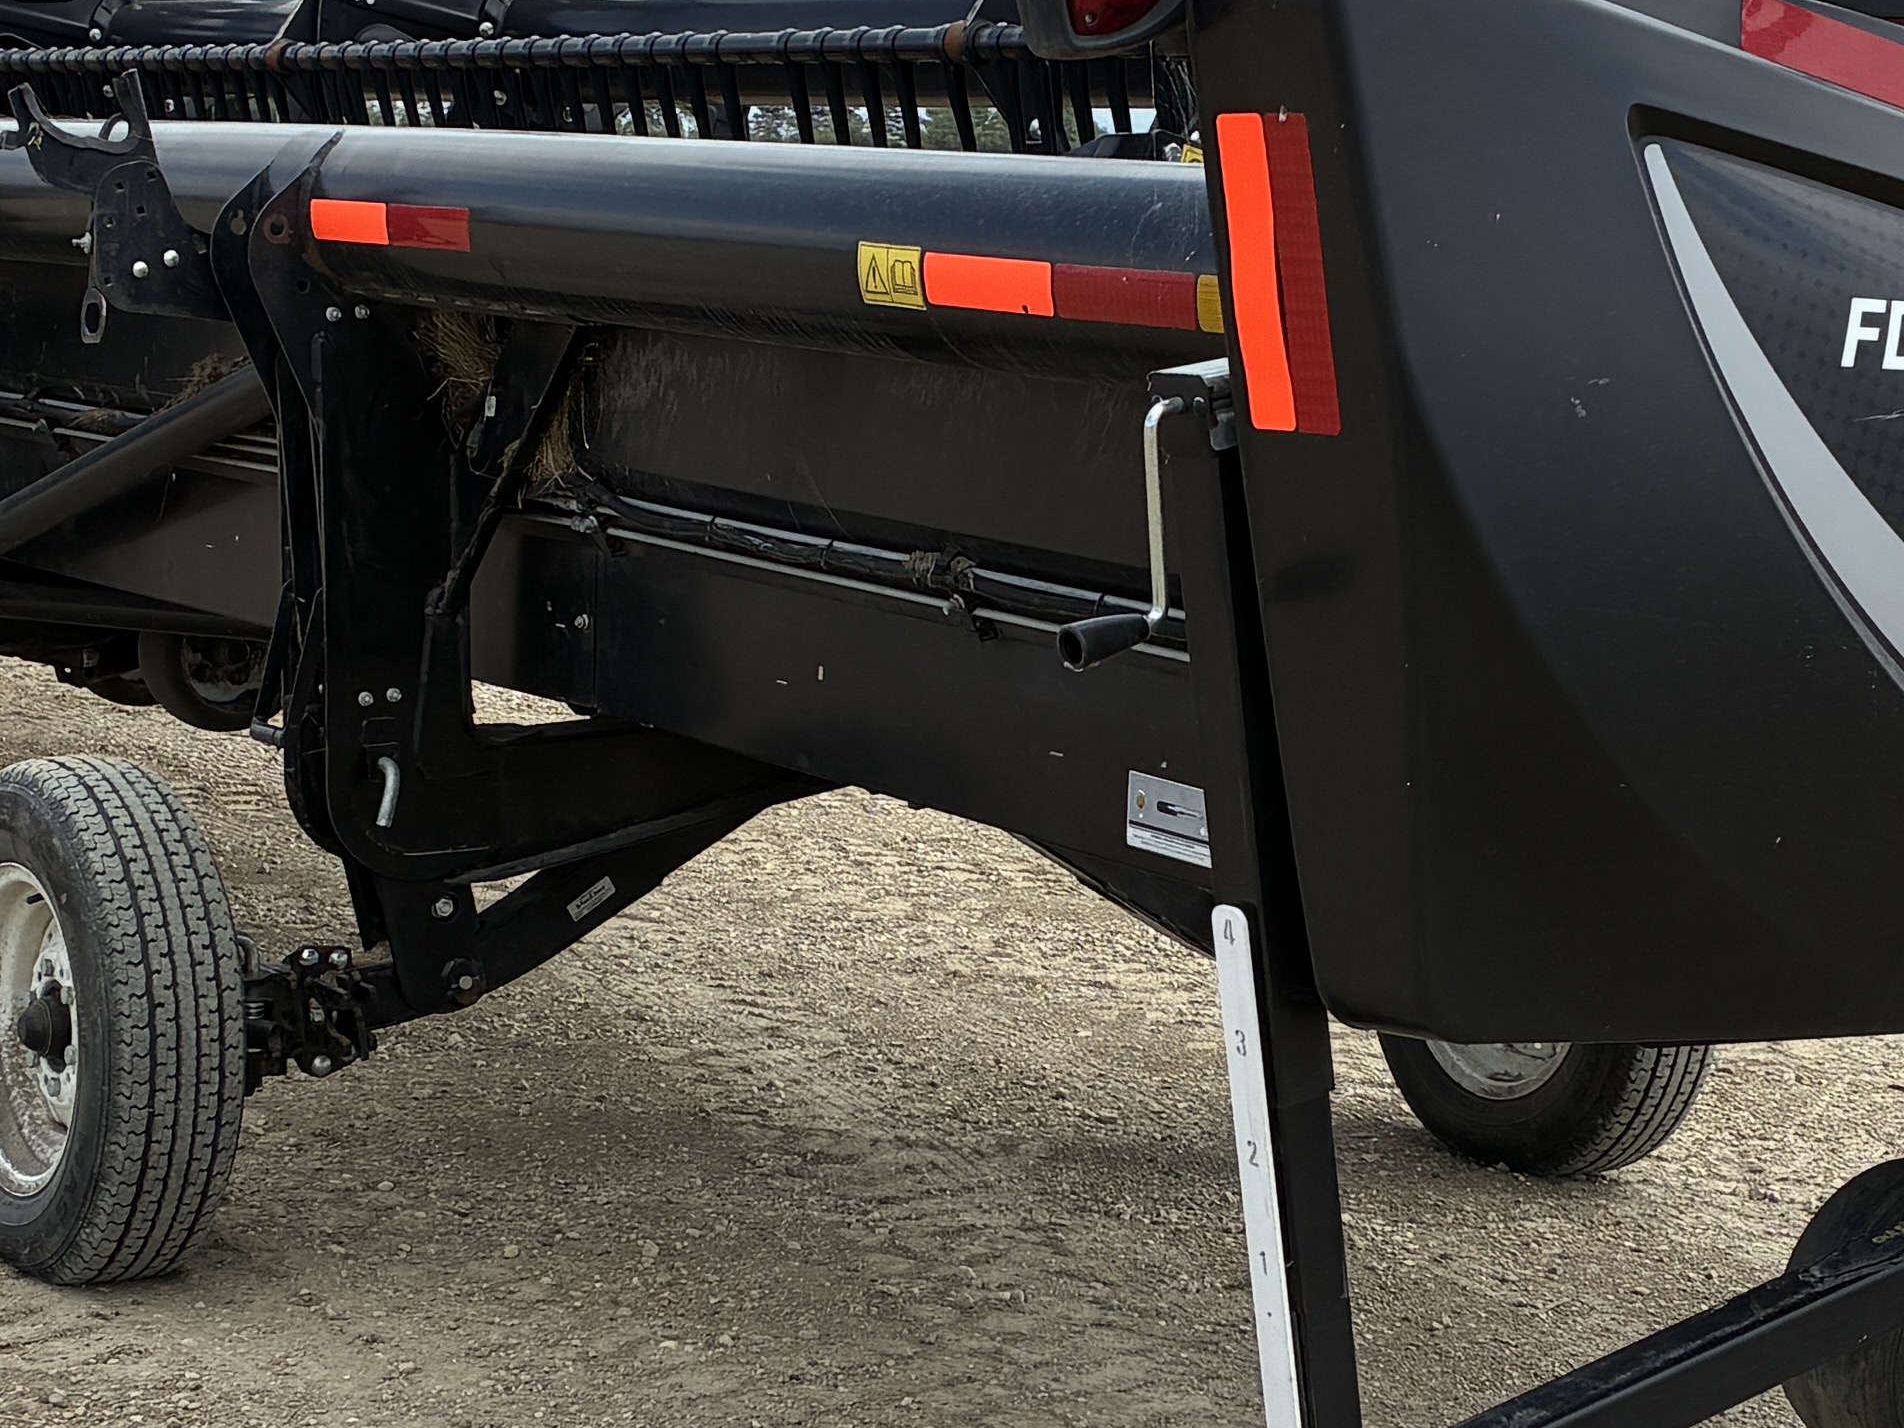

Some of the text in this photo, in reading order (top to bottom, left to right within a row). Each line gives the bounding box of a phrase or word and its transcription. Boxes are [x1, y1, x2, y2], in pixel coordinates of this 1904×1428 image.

[1223, 918, 1235, 946] 4
[1234, 1029, 1247, 1057] 3
[1247, 1140, 1259, 1168] 2
